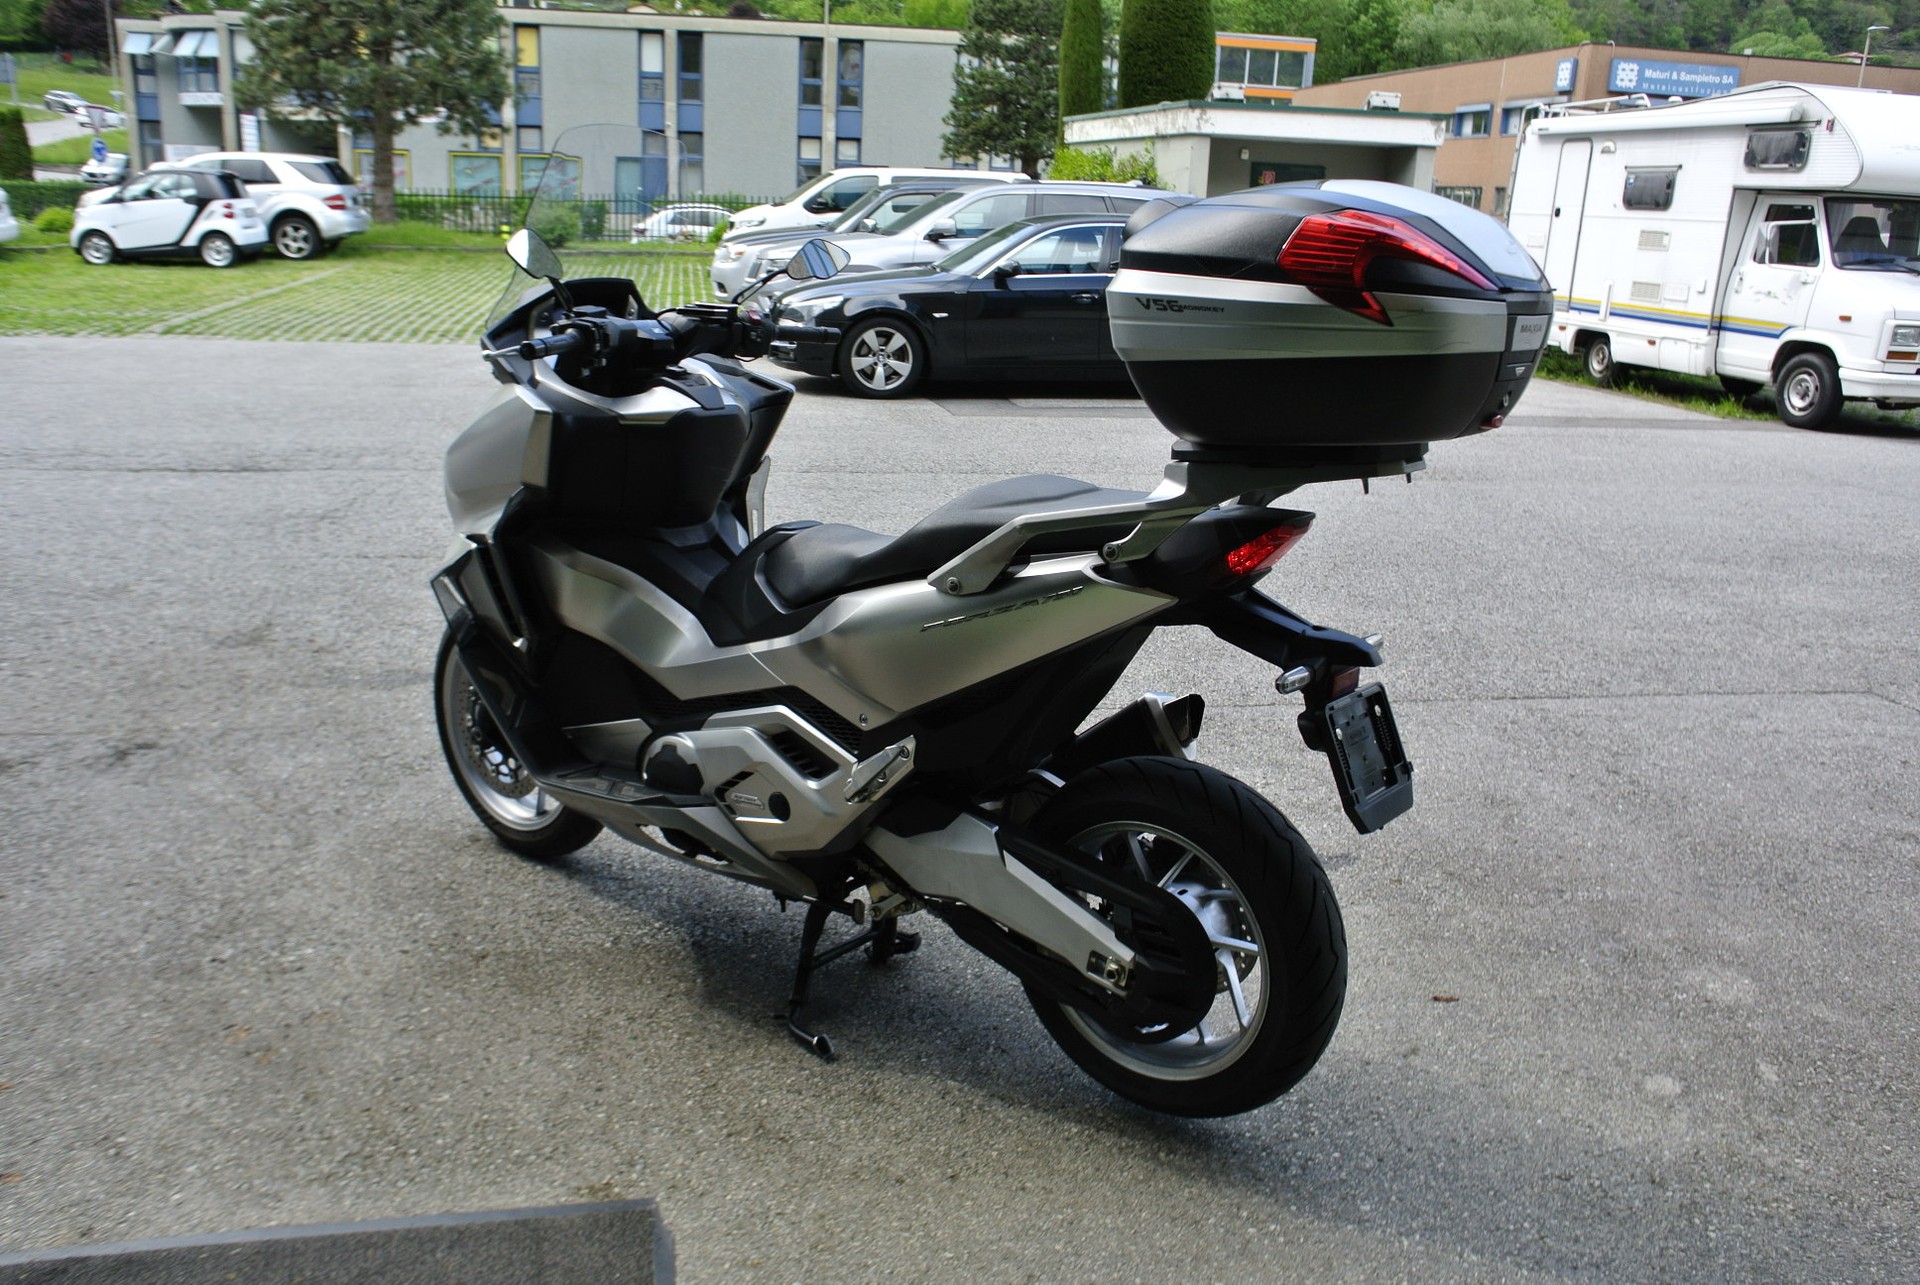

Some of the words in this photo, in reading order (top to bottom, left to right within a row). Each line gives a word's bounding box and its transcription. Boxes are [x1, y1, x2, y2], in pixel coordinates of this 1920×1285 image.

[1644, 68, 1670, 79] Maturi
[1671, 71, 1678, 81] &
[1679, 71, 1721, 84] Sampietro
[1721, 75, 1734, 84] SA
[1135, 297, 1184, 313] V56
